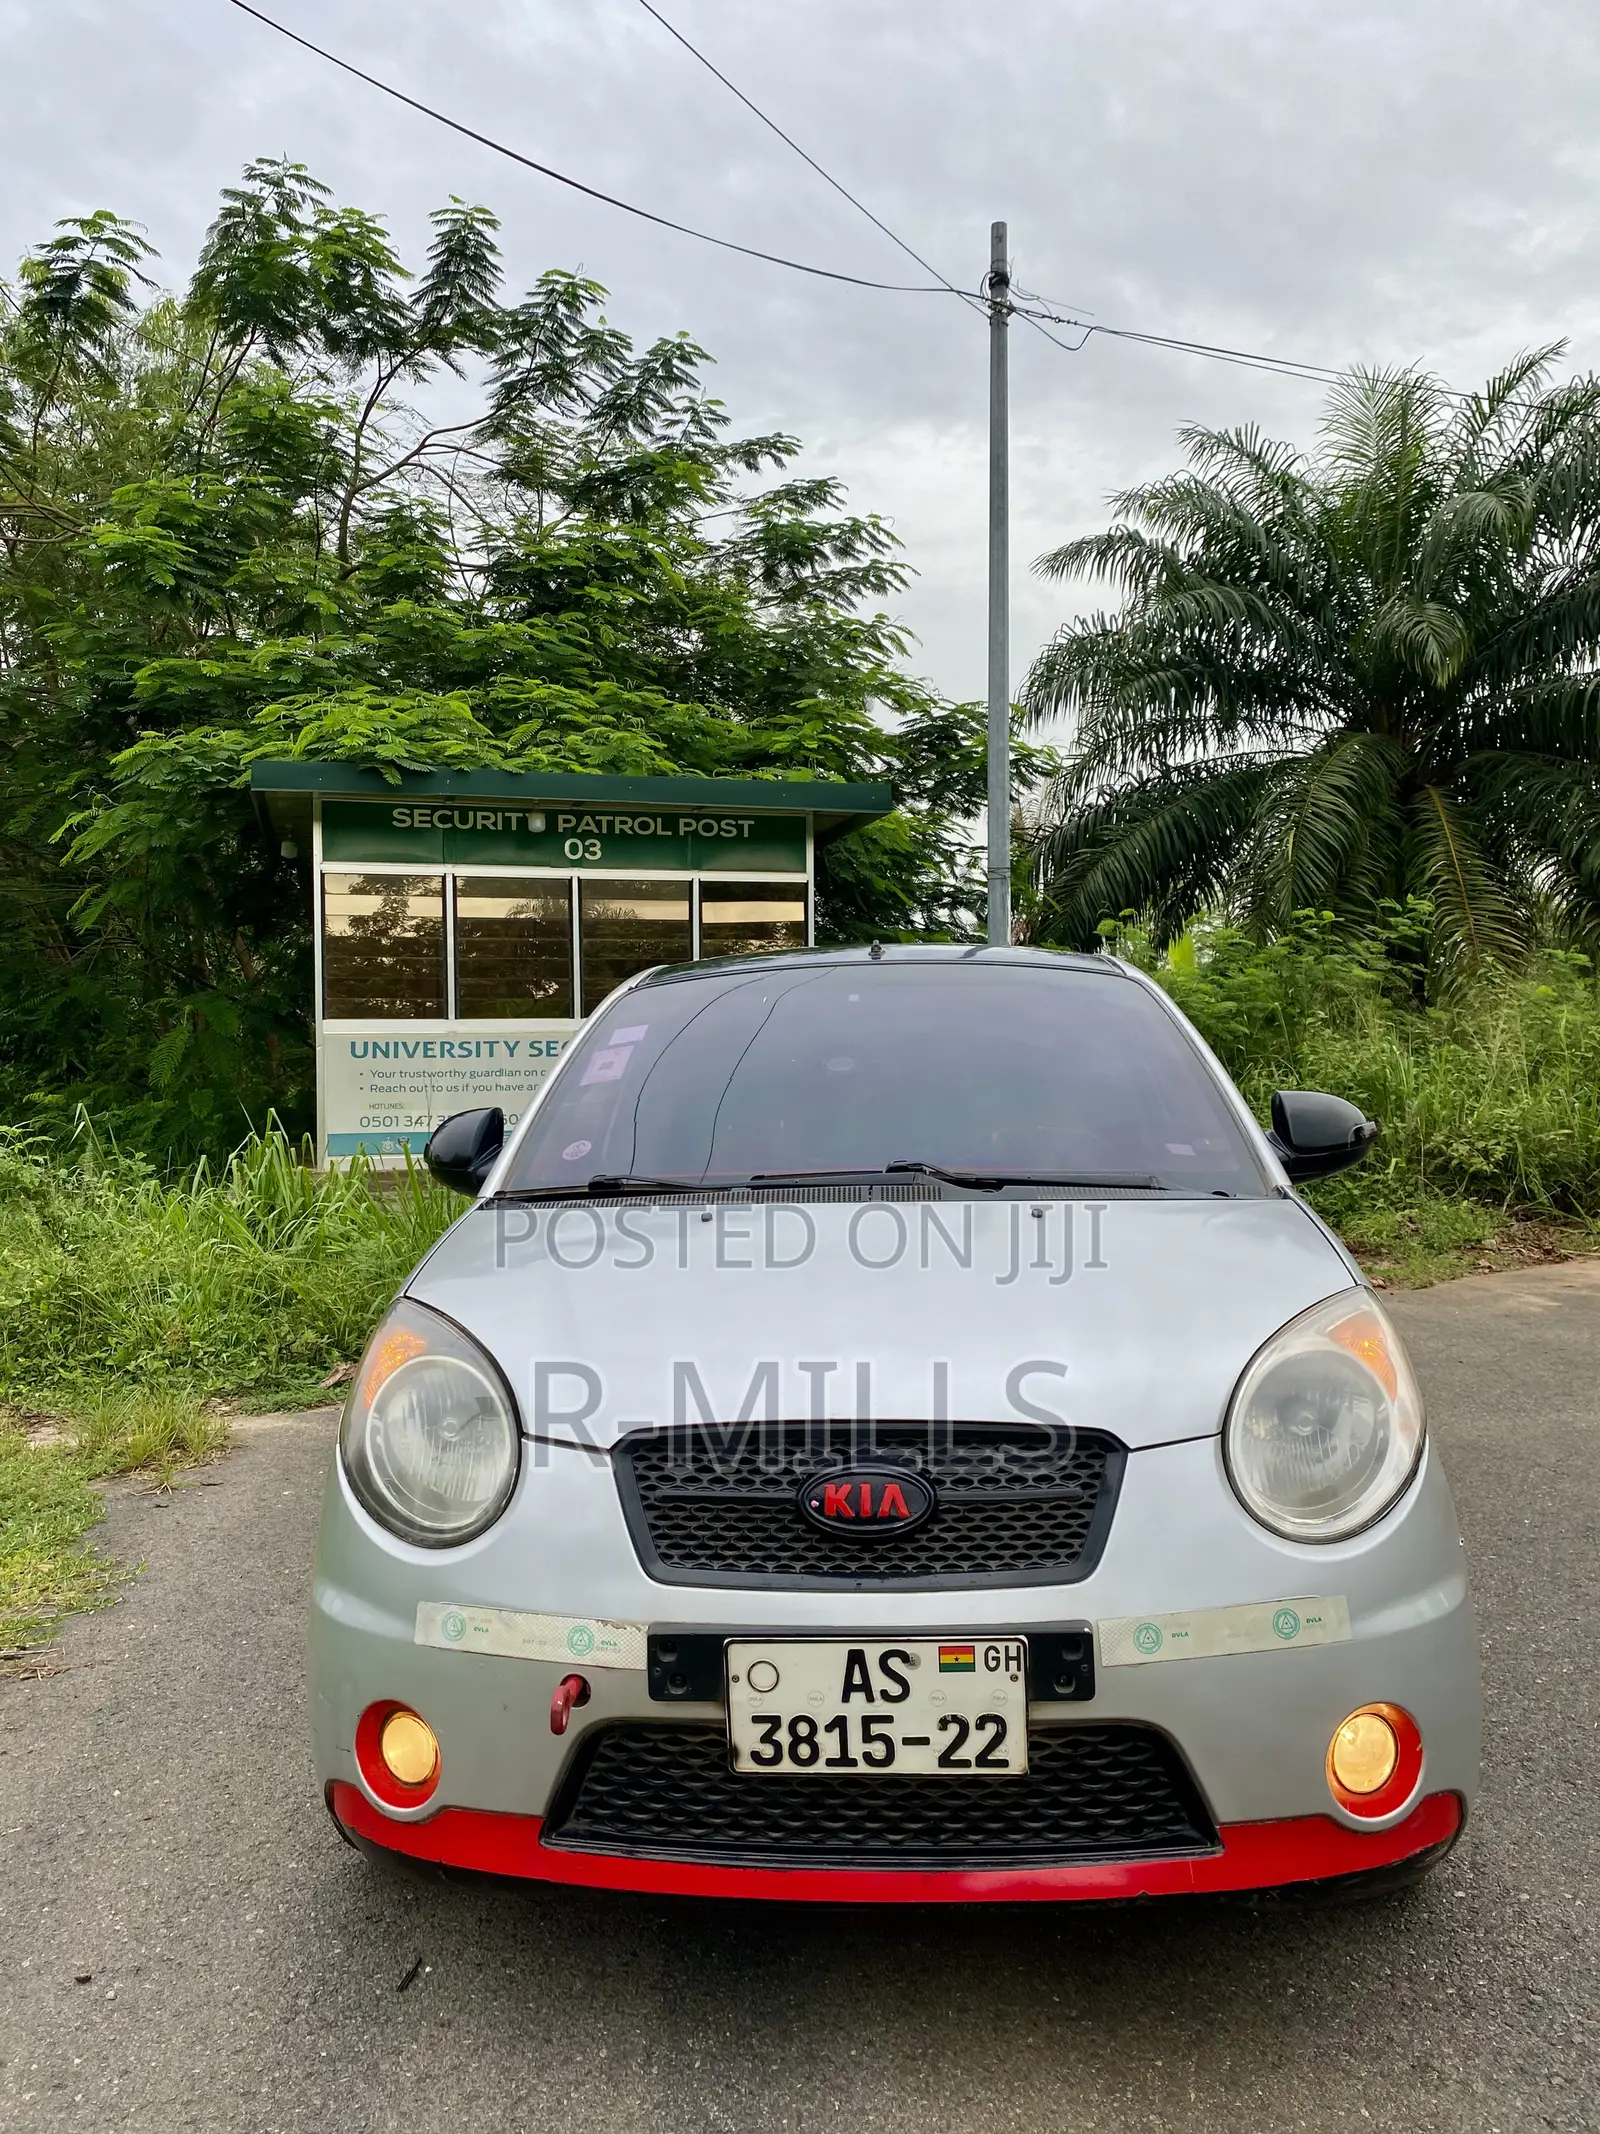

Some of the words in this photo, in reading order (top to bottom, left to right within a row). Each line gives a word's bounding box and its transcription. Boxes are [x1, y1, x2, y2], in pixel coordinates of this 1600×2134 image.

[392, 808, 546, 831] SECURIT
[557, 814, 672, 836] PATROL
[679, 818, 755, 838] POST
[564, 838, 602, 861] 03
[350, 1040, 520, 1059] UNIVERSITY
[370, 1069, 396, 1078] Your
[399, 1068, 467, 1080] trustworthy
[524, 1069, 538, 1077] on
[370, 1084, 406, 1093] Reach
[409, 1084, 428, 1093] out
[431, 1085, 443, 1093] to
[446, 1085, 460, 1093] us
[462, 1083, 470, 1092] if
[472, 1084, 493, 1094] you
[360, 1115, 399, 1128] 0501
[824, 1483, 911, 1518] KIA
[1306, 1616, 1322, 1625] DVLA
[984, 1645, 1022, 1672] GH
[841, 1648, 911, 1703] AS
[750, 1713, 1009, 1768] 3815-22
